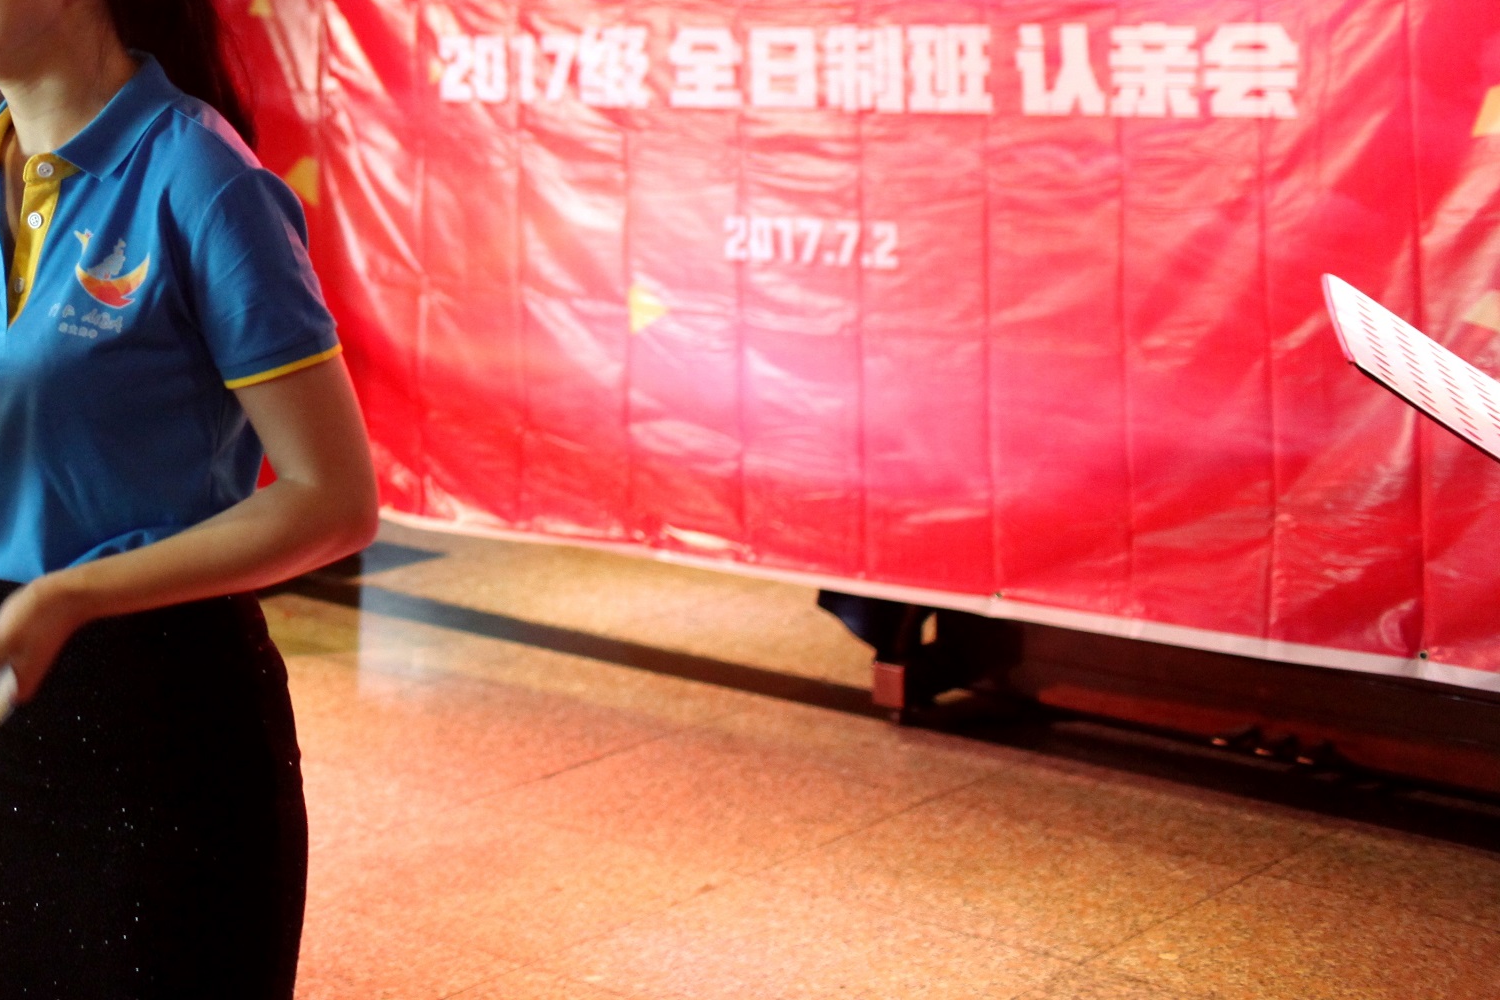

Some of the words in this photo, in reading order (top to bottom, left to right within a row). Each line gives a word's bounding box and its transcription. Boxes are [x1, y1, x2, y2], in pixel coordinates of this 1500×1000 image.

[439, 25, 649, 108] 2017级
[668, 24, 995, 114] 全日制班
[1015, 22, 1299, 119] 认亲会
[724, 215, 899, 268] 2017.7.2
